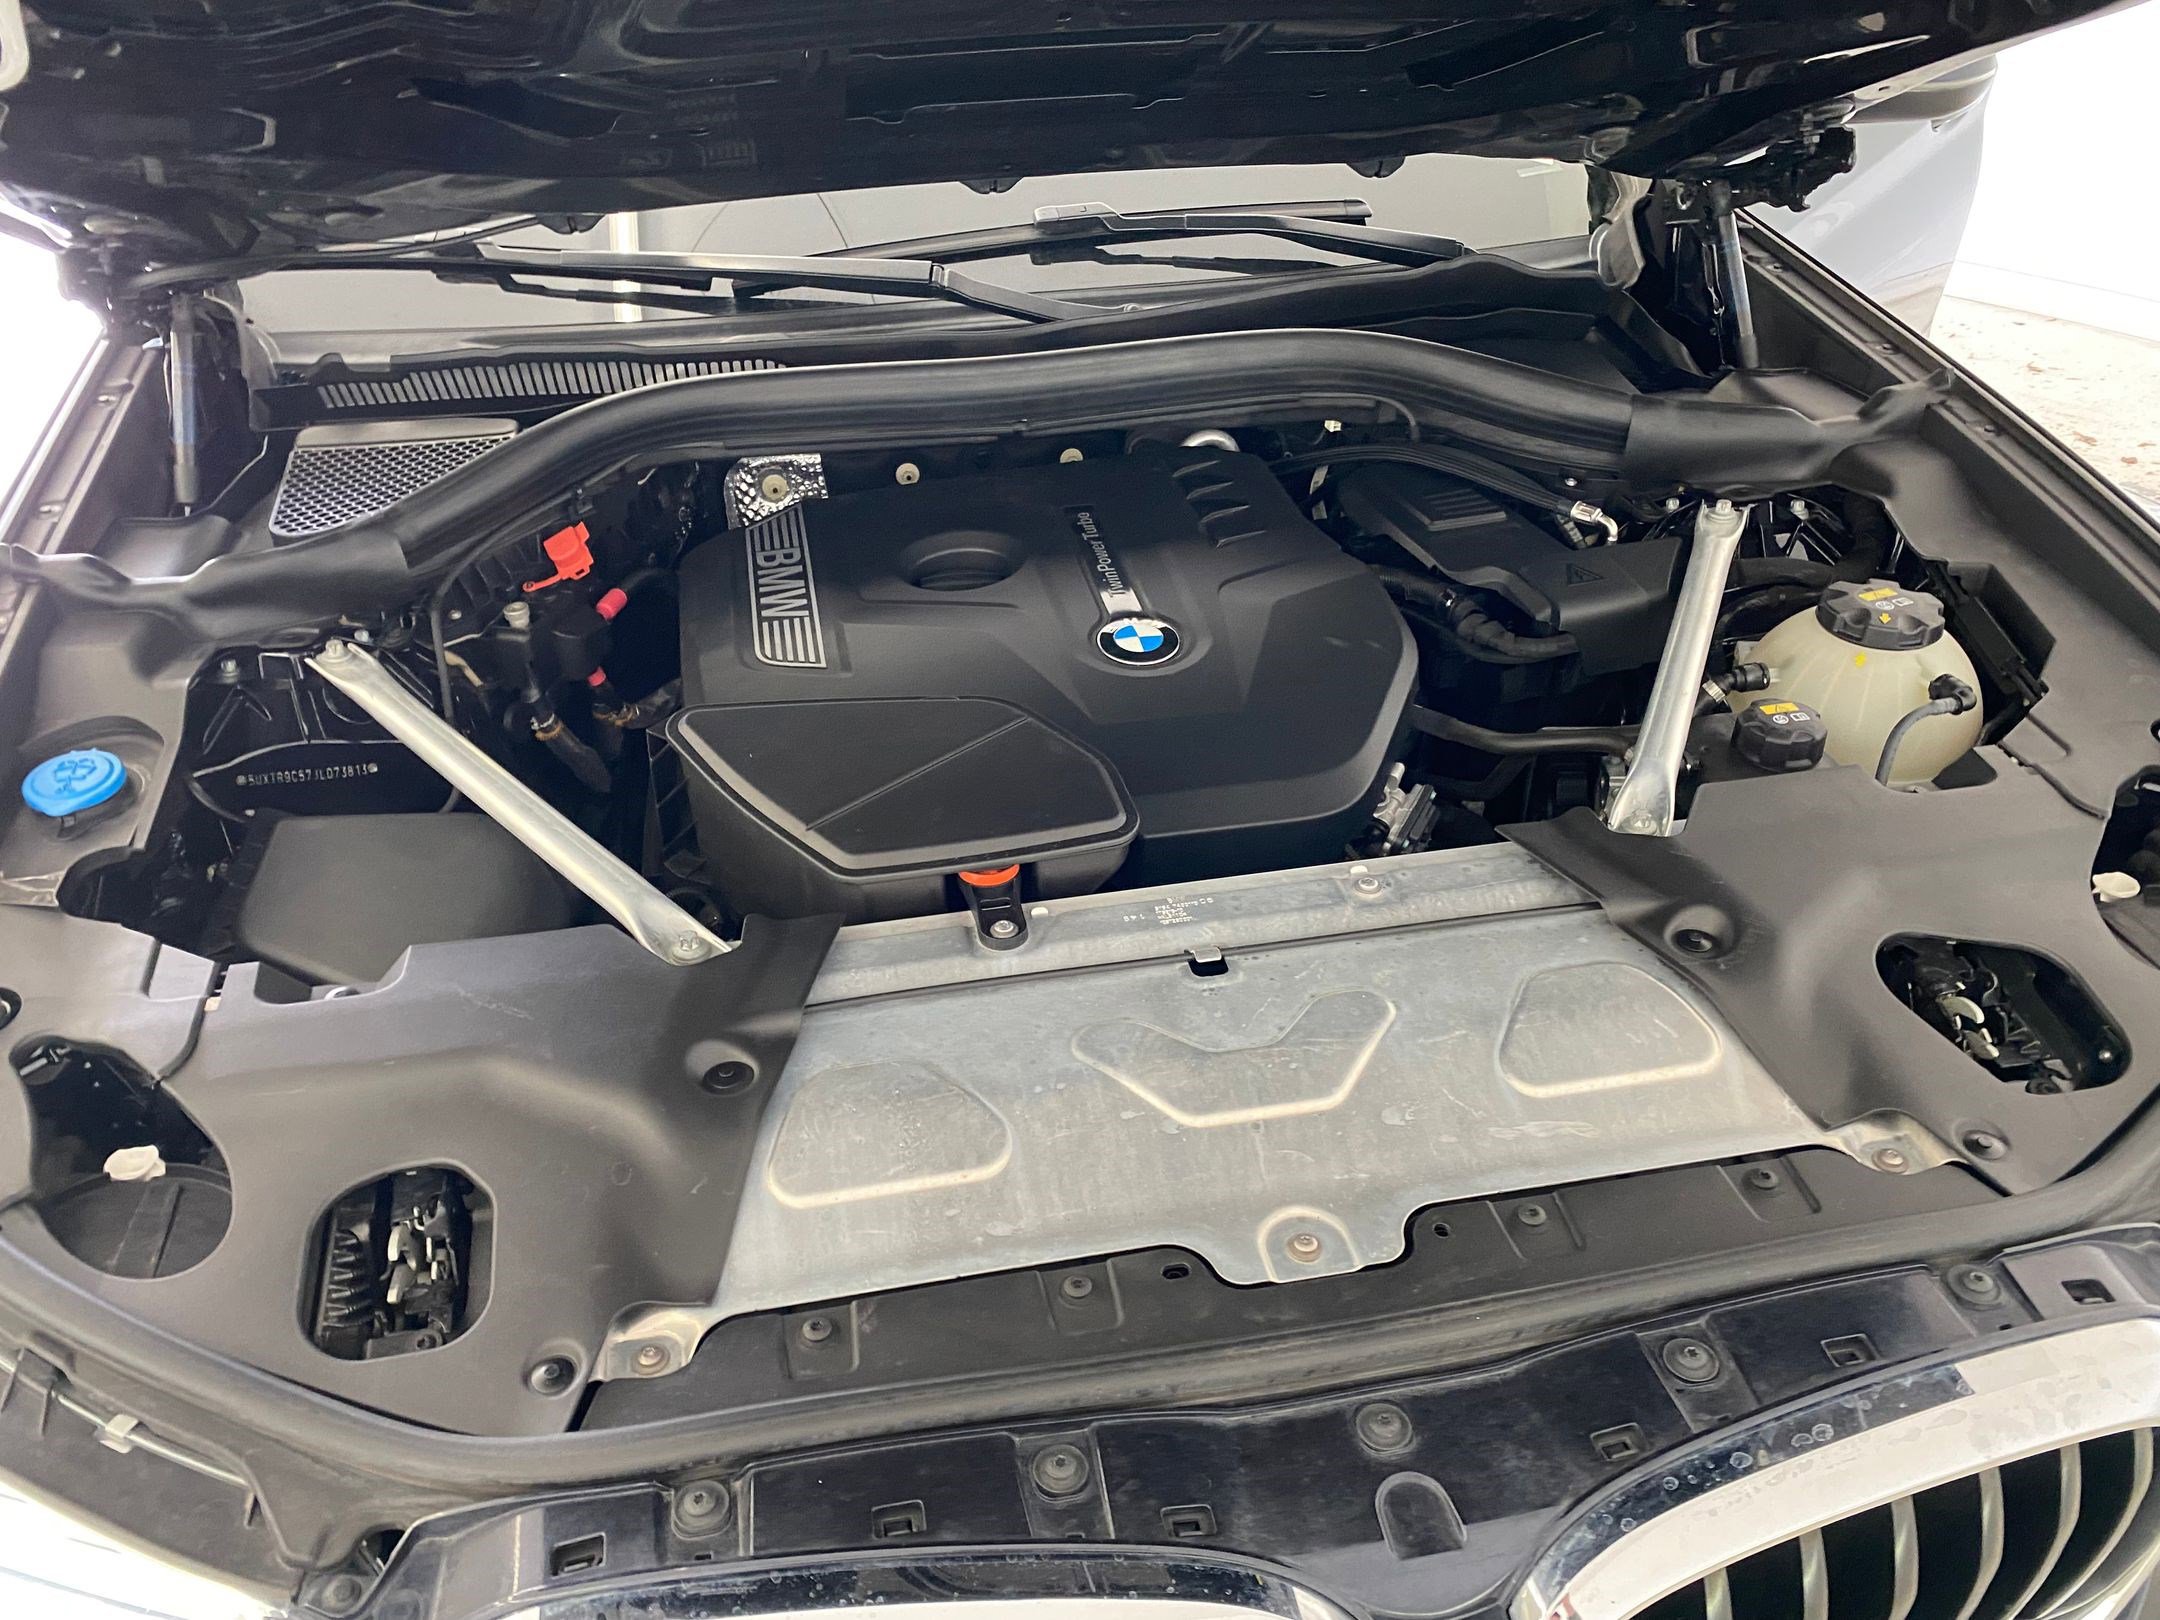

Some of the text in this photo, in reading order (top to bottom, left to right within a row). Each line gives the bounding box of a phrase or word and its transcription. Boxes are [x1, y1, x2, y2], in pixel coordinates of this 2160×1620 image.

[755, 547, 810, 618] BMW
[1077, 511, 1126, 598] TwinPower Turbo
